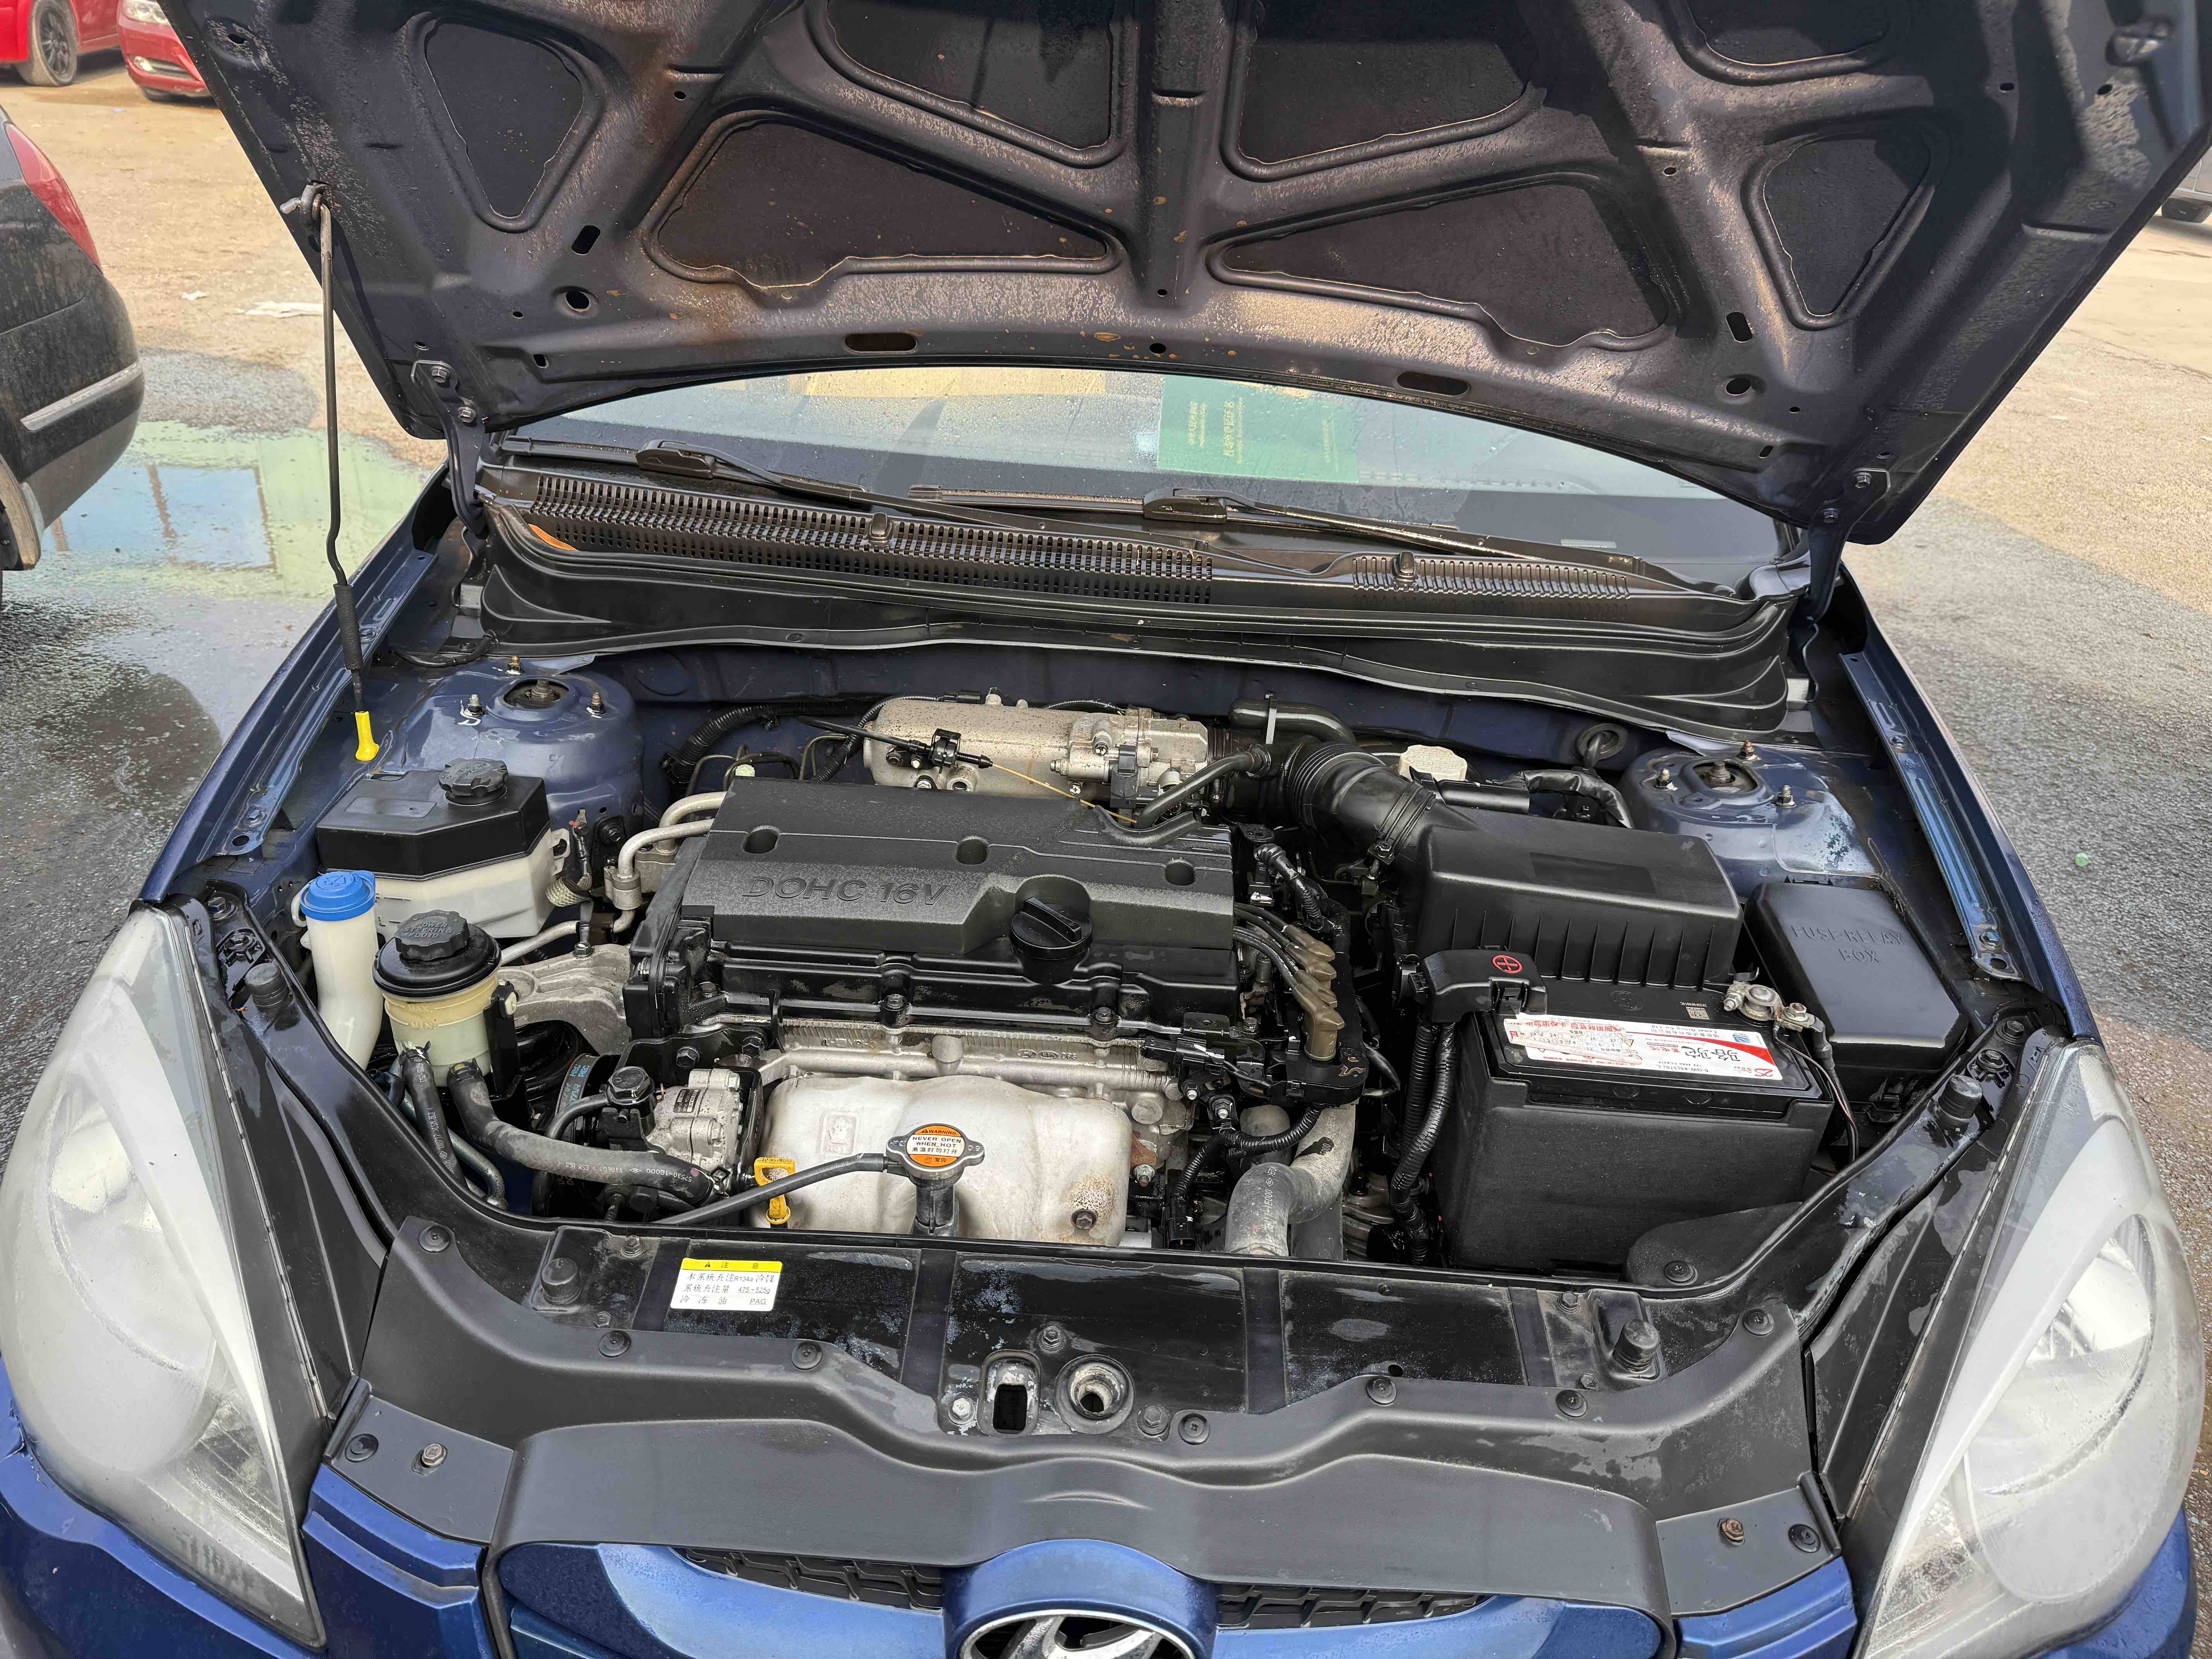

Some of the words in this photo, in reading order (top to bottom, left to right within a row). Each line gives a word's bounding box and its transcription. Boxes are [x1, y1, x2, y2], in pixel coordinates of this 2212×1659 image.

[742, 876, 867, 902] DOHC
[879, 883, 951, 905] 16V
[1838, 948, 1881, 963] BOX
[1681, 1046, 1741, 1062] 骆驼
[646, 1168, 692, 1183] 57530-1G000
